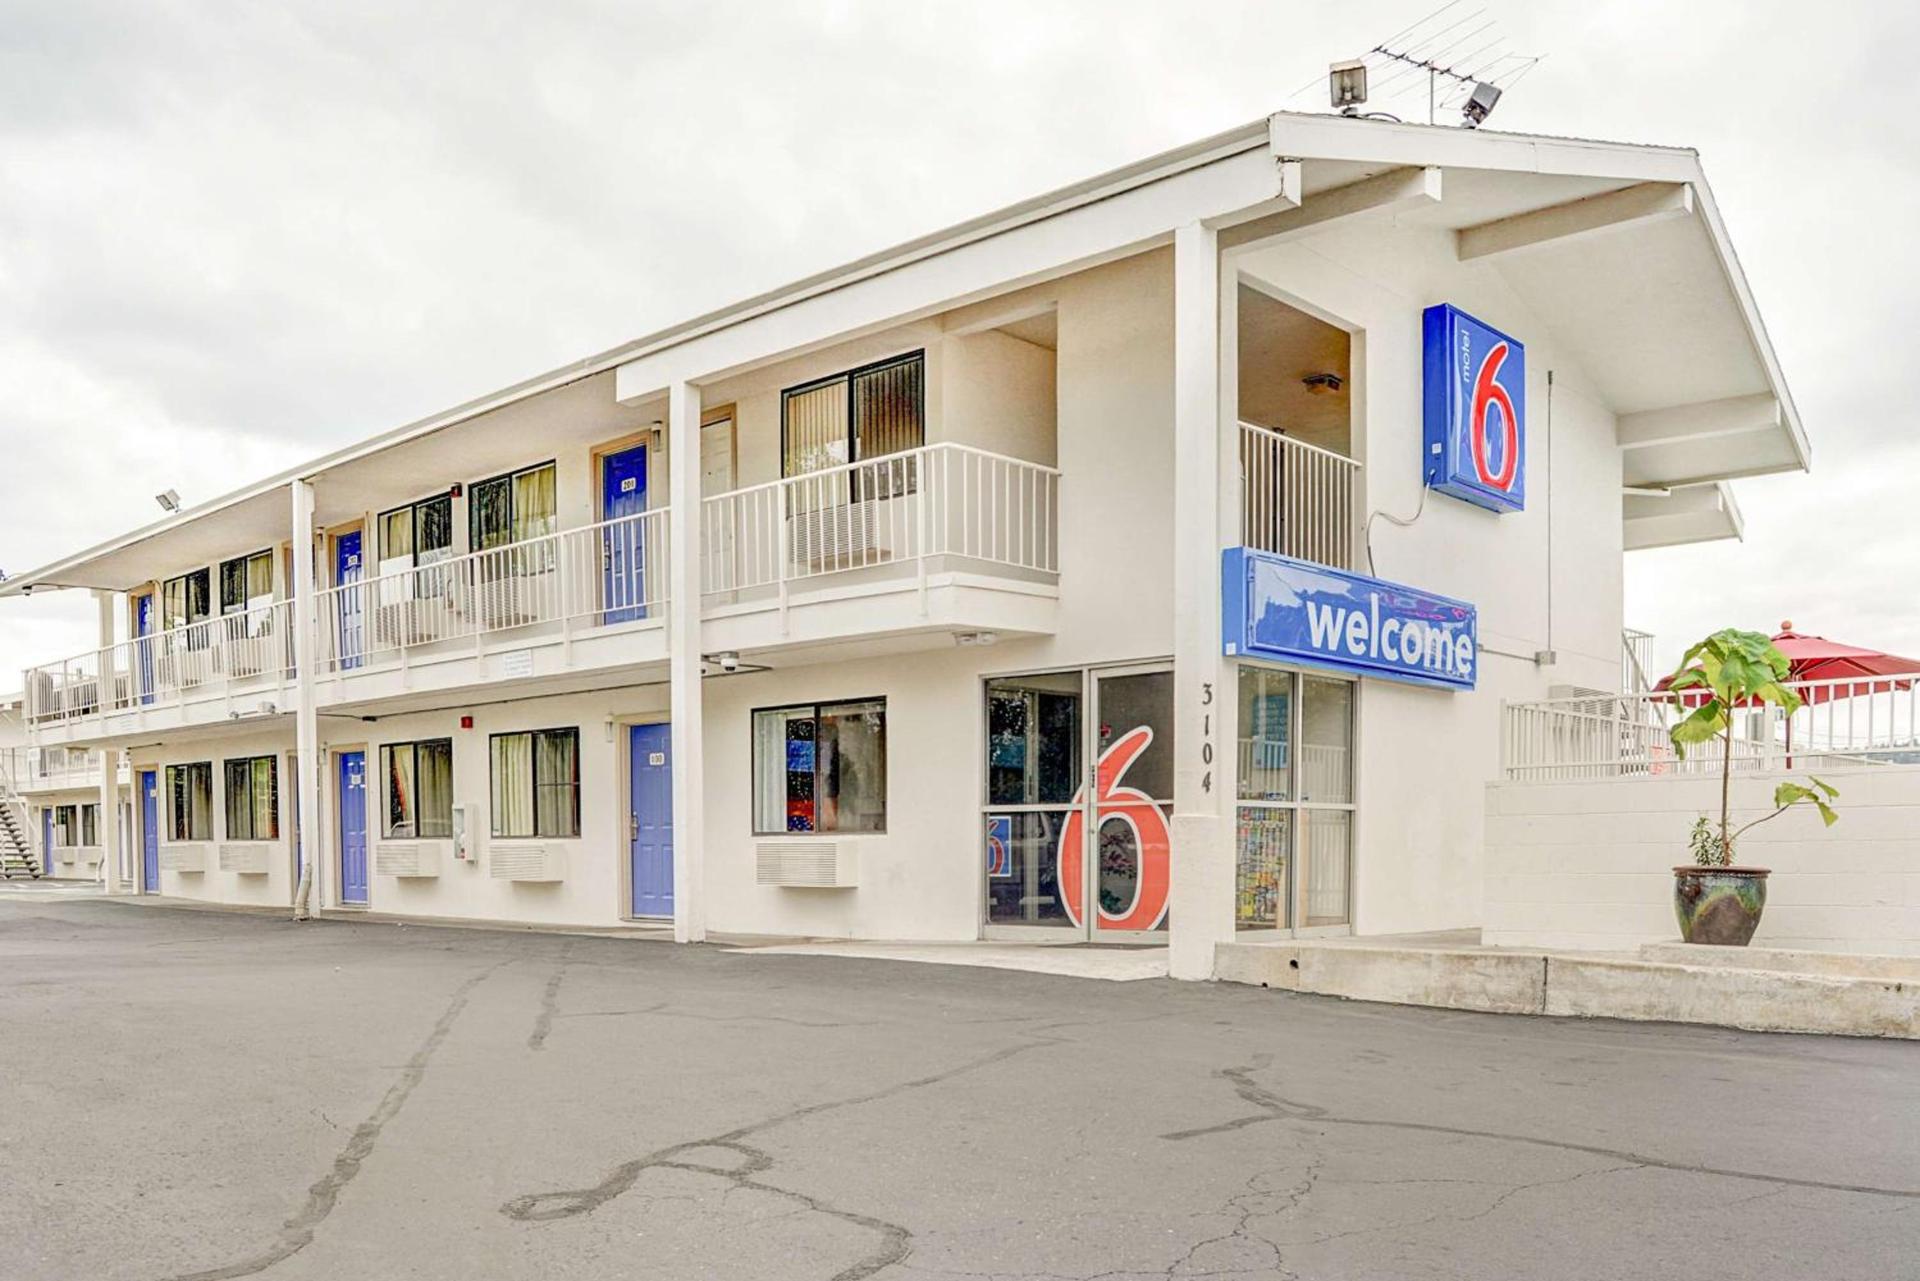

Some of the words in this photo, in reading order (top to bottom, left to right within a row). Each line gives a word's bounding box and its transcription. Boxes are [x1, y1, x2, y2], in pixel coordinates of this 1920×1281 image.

[1461, 329, 1472, 383] motel
[1470, 340, 1519, 493] 6
[1306, 592, 1474, 674] welcome
[1202, 683, 1213, 793] 3104
[1057, 725, 1170, 930] 6
